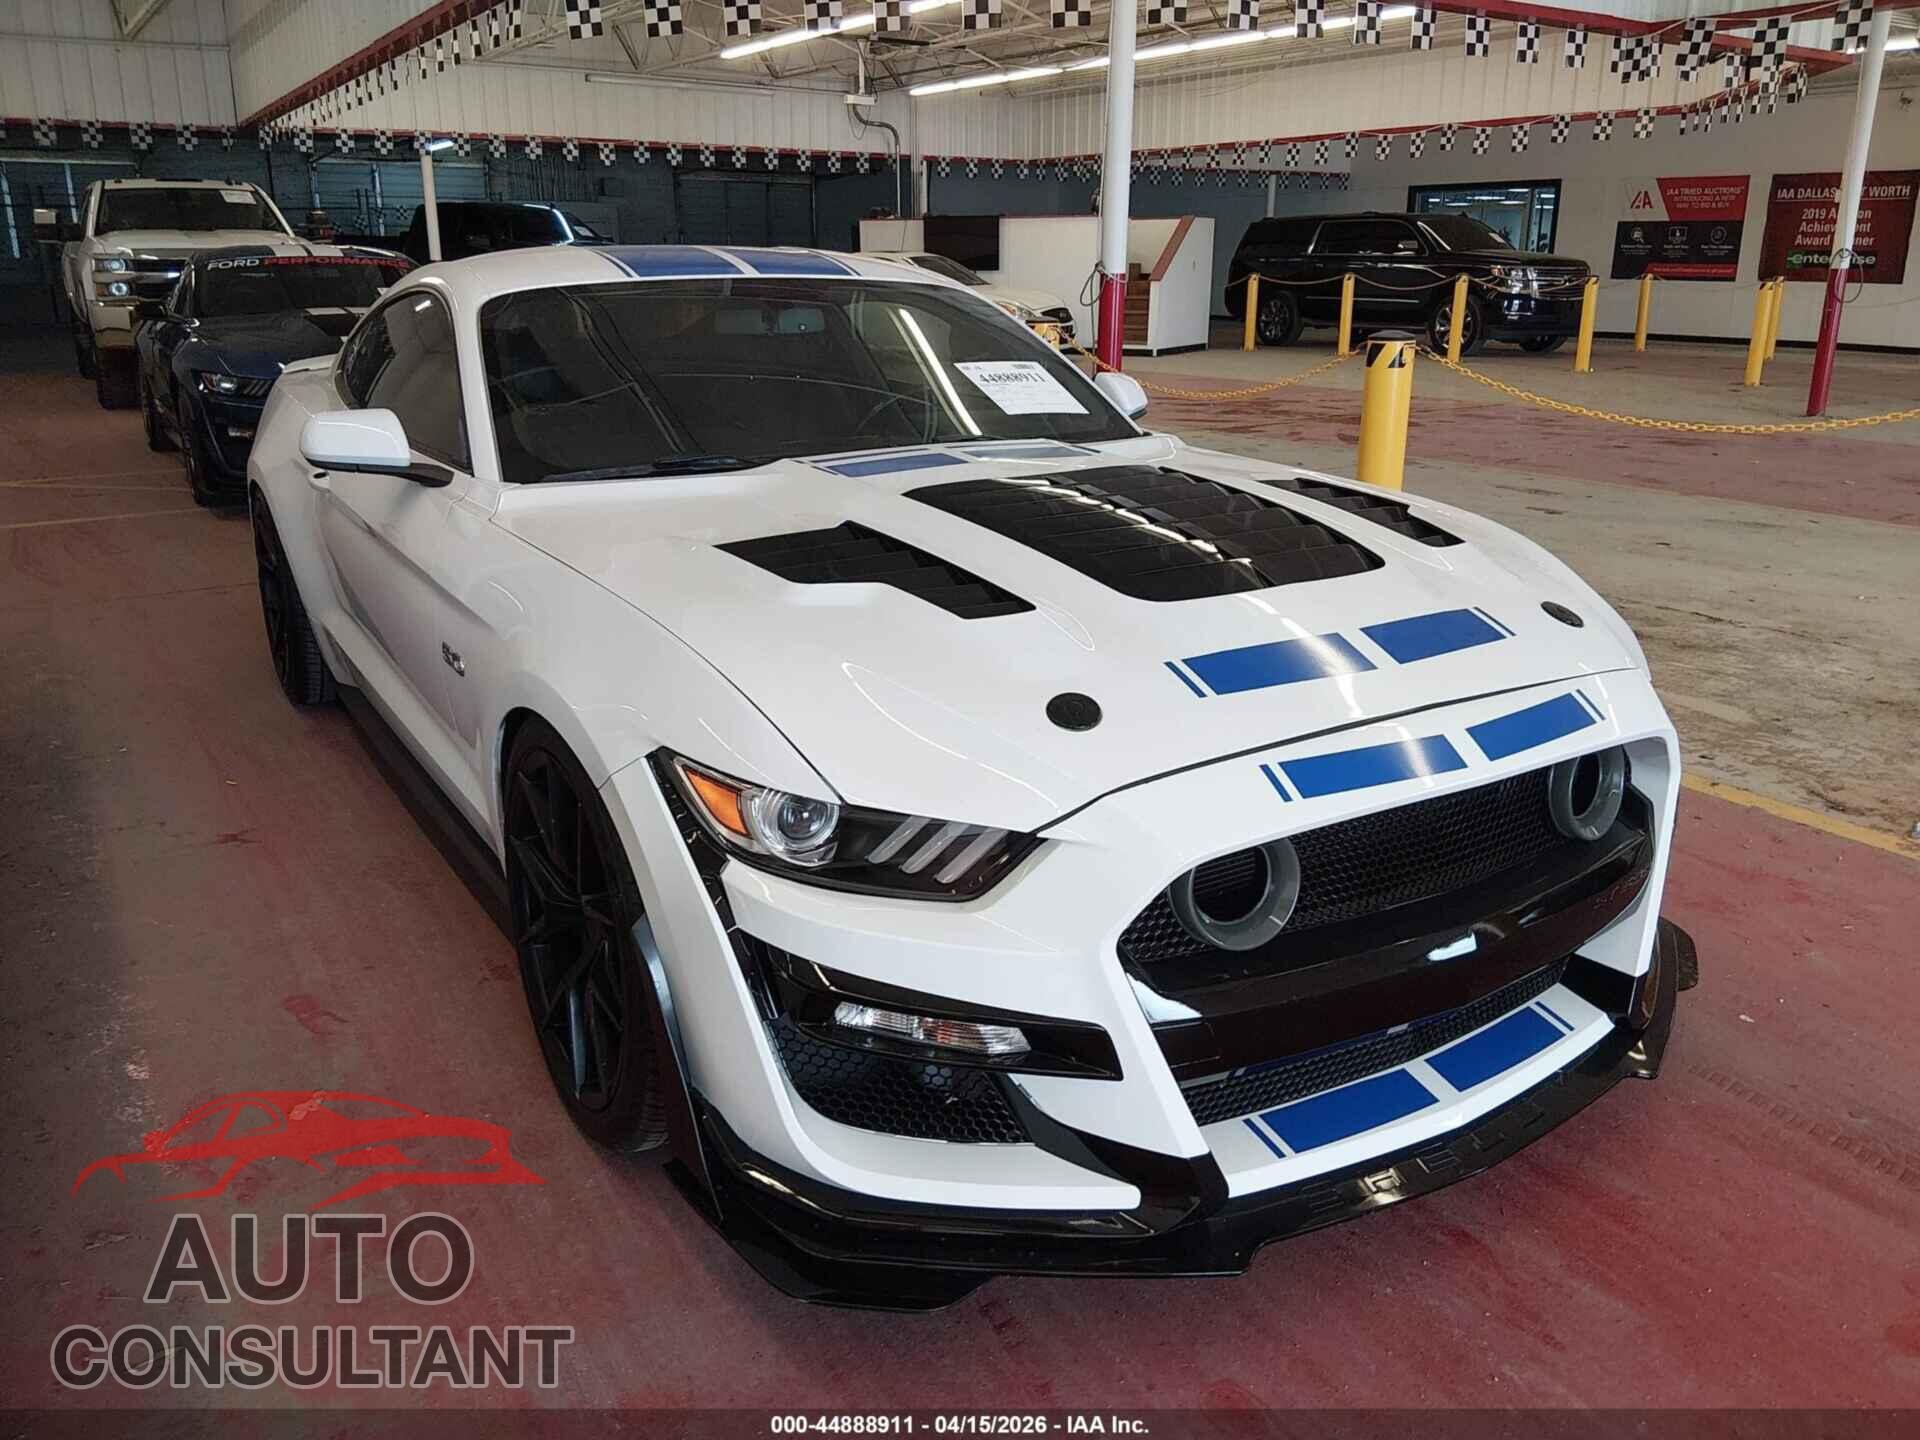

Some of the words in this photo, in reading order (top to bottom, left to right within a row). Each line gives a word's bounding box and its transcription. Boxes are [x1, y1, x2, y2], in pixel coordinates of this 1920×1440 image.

[1777, 188, 1795, 199] IAA
[1797, 187, 1838, 199] DALLAS
[1869, 185, 1911, 197] WORTH
[1802, 208, 1826, 220] 2019
[1794, 234, 1831, 246] Award
[207, 258, 260, 271] FORD
[264, 256, 410, 269] PERFORMANCE
